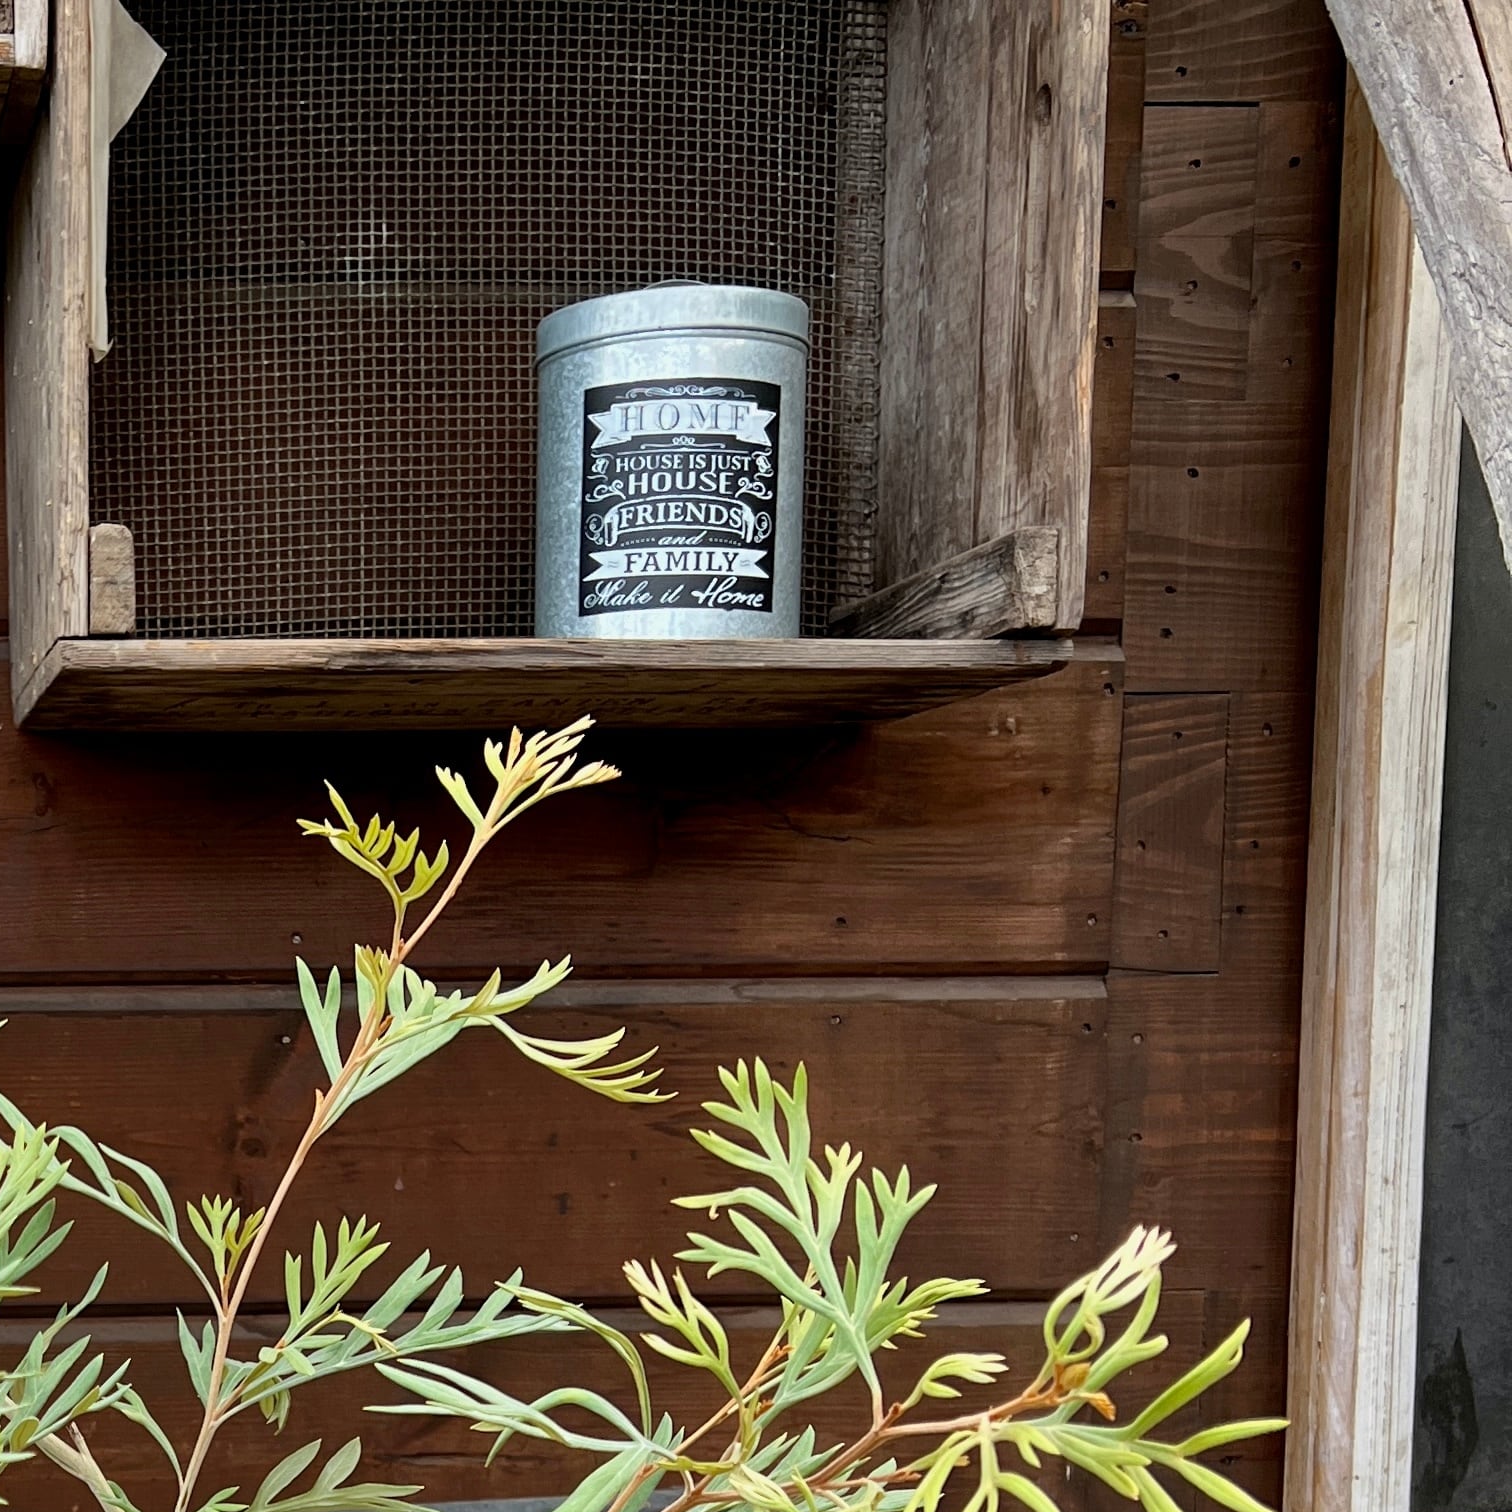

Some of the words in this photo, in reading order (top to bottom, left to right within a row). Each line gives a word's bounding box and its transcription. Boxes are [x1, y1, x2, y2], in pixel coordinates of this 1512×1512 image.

[620, 402, 750, 432] HOME
[615, 455, 683, 473] HOUSE
[688, 455, 706, 471] IS
[710, 455, 752, 474] JUST
[628, 472, 734, 495] HOUSE
[619, 502, 743, 529] FRIENDS
[658, 531, 706, 546] and
[624, 552, 740, 574] FAMILY
[584, 579, 653, 609] Make
[660, 584, 684, 604] it
[692, 577, 765, 608] Home
